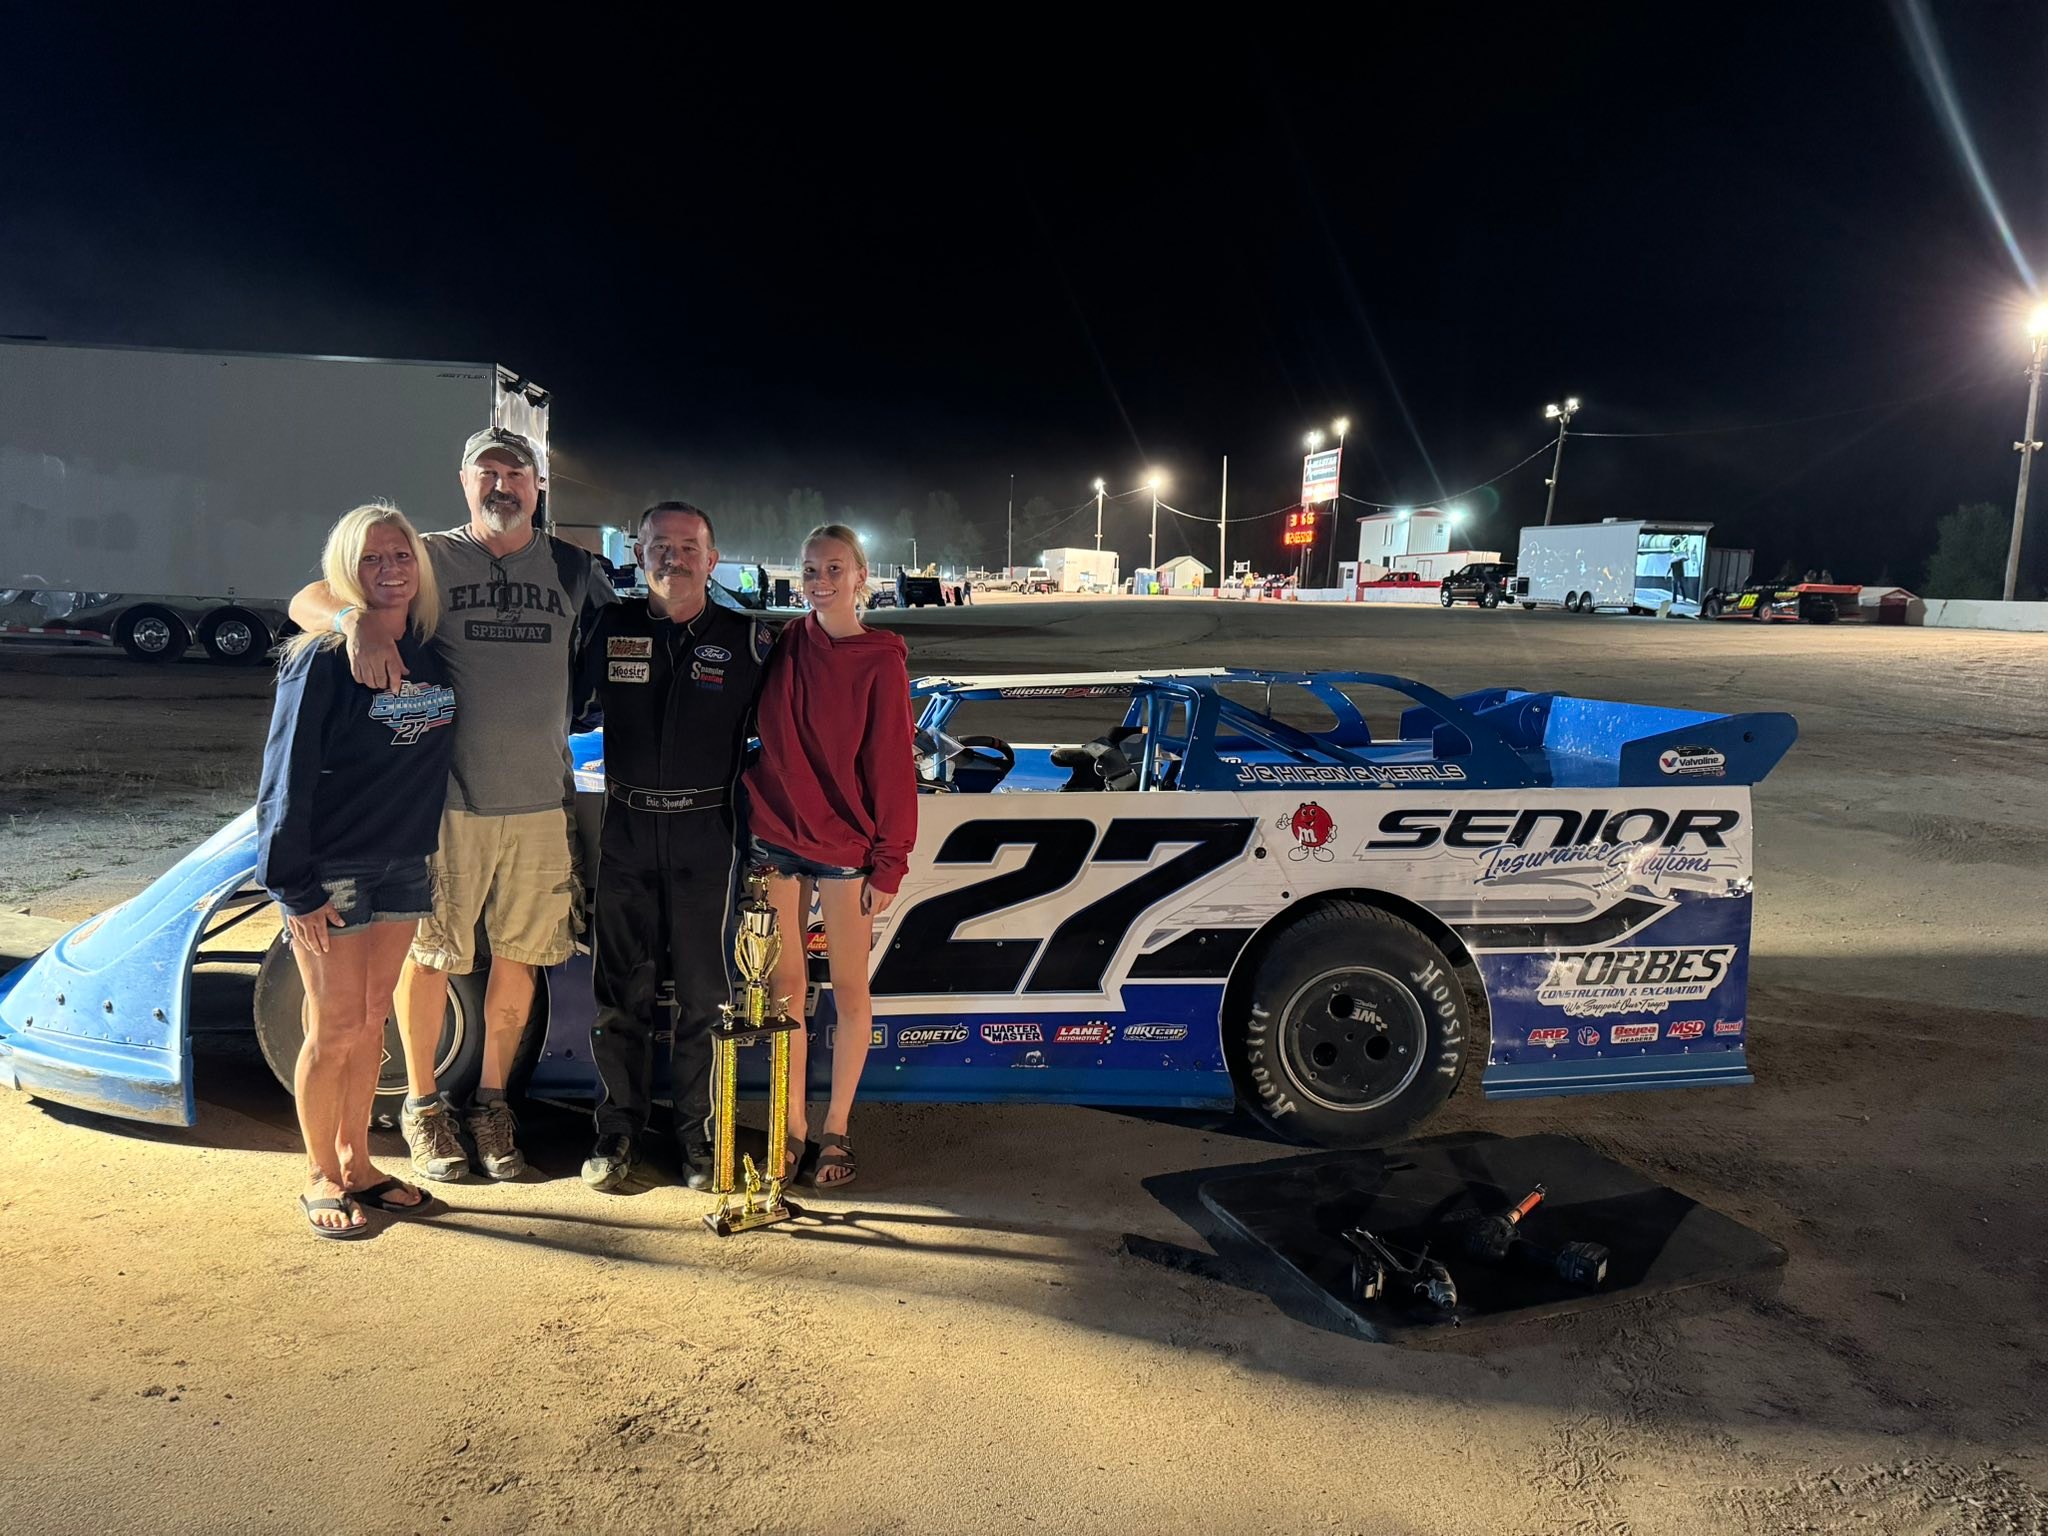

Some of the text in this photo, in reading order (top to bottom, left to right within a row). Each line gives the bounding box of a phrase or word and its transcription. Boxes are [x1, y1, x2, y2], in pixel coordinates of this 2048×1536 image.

[472, 624, 545, 639] SPEEDWAY
[701, 648, 725, 659] Ford
[610, 665, 647, 677] Hoosier
[390, 719, 428, 745] 27
[1679, 757, 1719, 767] Valvoline
[1237, 765, 1254, 782] J
[1373, 764, 1467, 783] METALS
[645, 795, 694, 811] Eric Spangler
[1364, 808, 1740, 850] SENIOR
[1474, 842, 1738, 887] Insurance Slutions
[870, 817, 1258, 995] 27
[1546, 948, 1729, 987] FORBES
[1541, 984, 1706, 1000] CONSTRUCTION & EXCAVATION
[1565, 1002, 1581, 1013] We
[1582, 1000, 1620, 1015] Support
[1640, 999, 1667, 1014] Troops
[1410, 959, 1464, 1077] Hoosier
[900, 1029, 967, 1041] COMETIC
[982, 1024, 1038, 1035] QUARTER
[1060, 1027, 1103, 1036] LANE
[1529, 1028, 1568, 1040] ARP
[1614, 1026, 1657, 1038] Beyea
[1668, 1021, 1705, 1035] MSD
[992, 1033, 1041, 1042] MASTER
[1246, 1003, 1298, 1119] Hoosier
